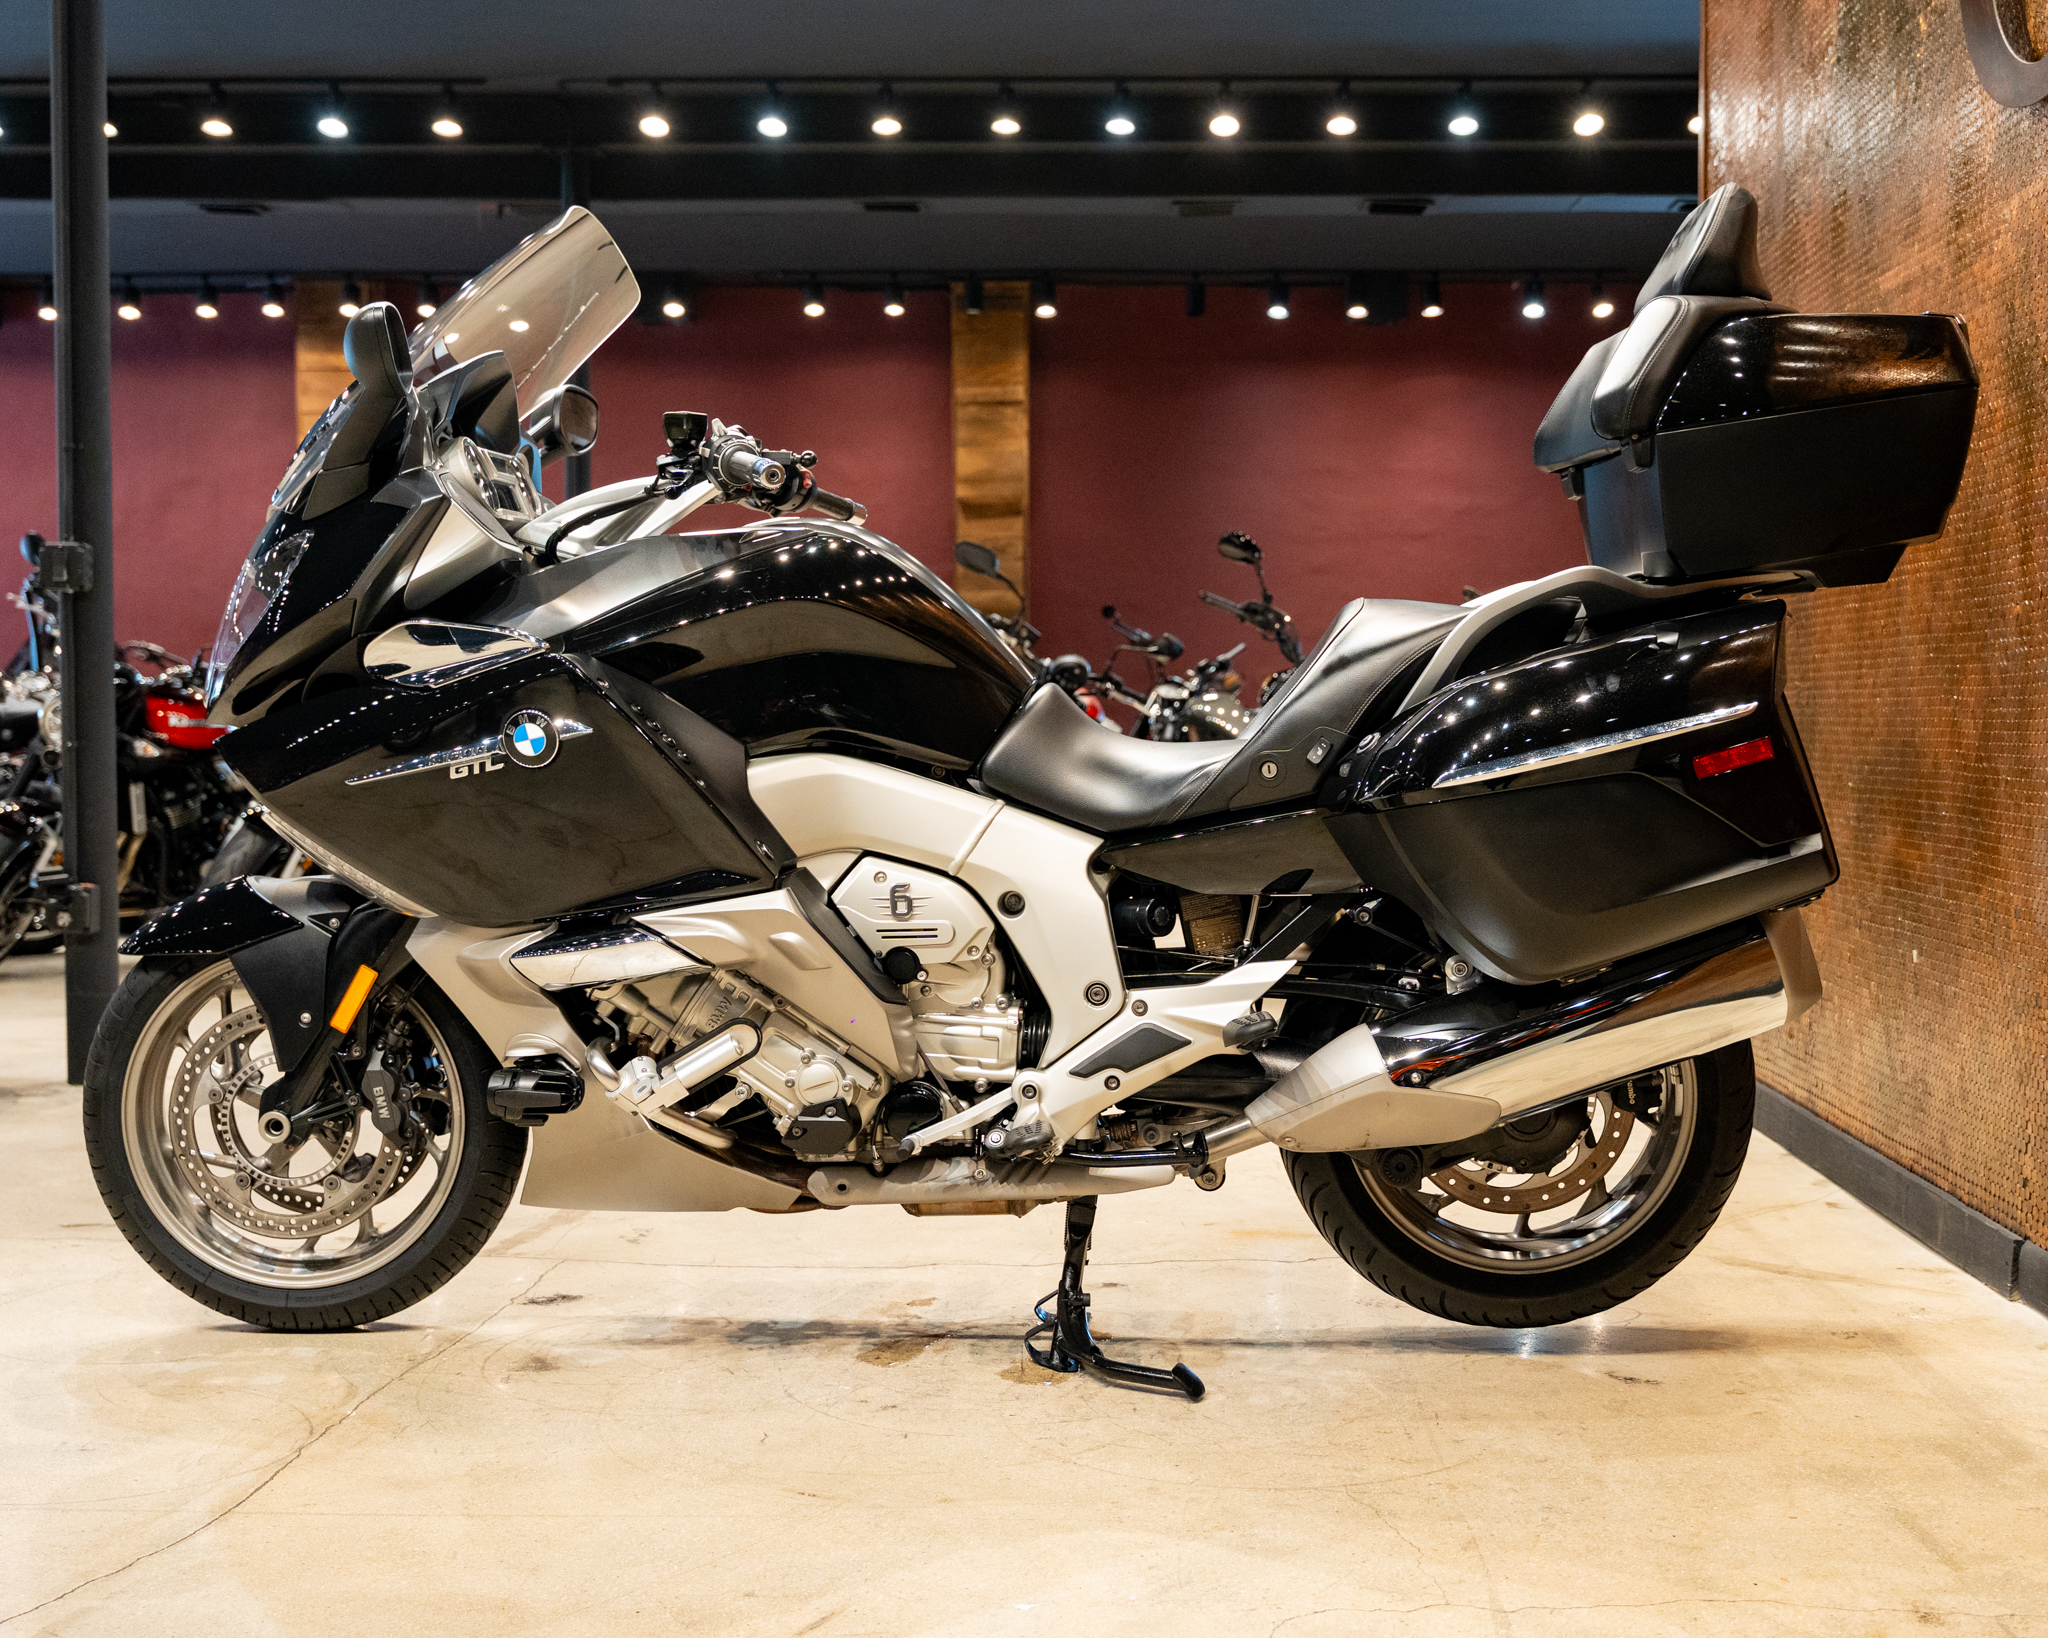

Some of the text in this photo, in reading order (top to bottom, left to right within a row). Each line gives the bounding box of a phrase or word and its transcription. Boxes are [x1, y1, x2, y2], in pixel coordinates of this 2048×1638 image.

[506, 714, 548, 736] BMW
[450, 756, 504, 779] GTL
[890, 882, 913, 922] 6
[706, 996, 732, 1029] BMW
[373, 1086, 390, 1119] BMW
[1627, 1080, 1636, 1104] embo
